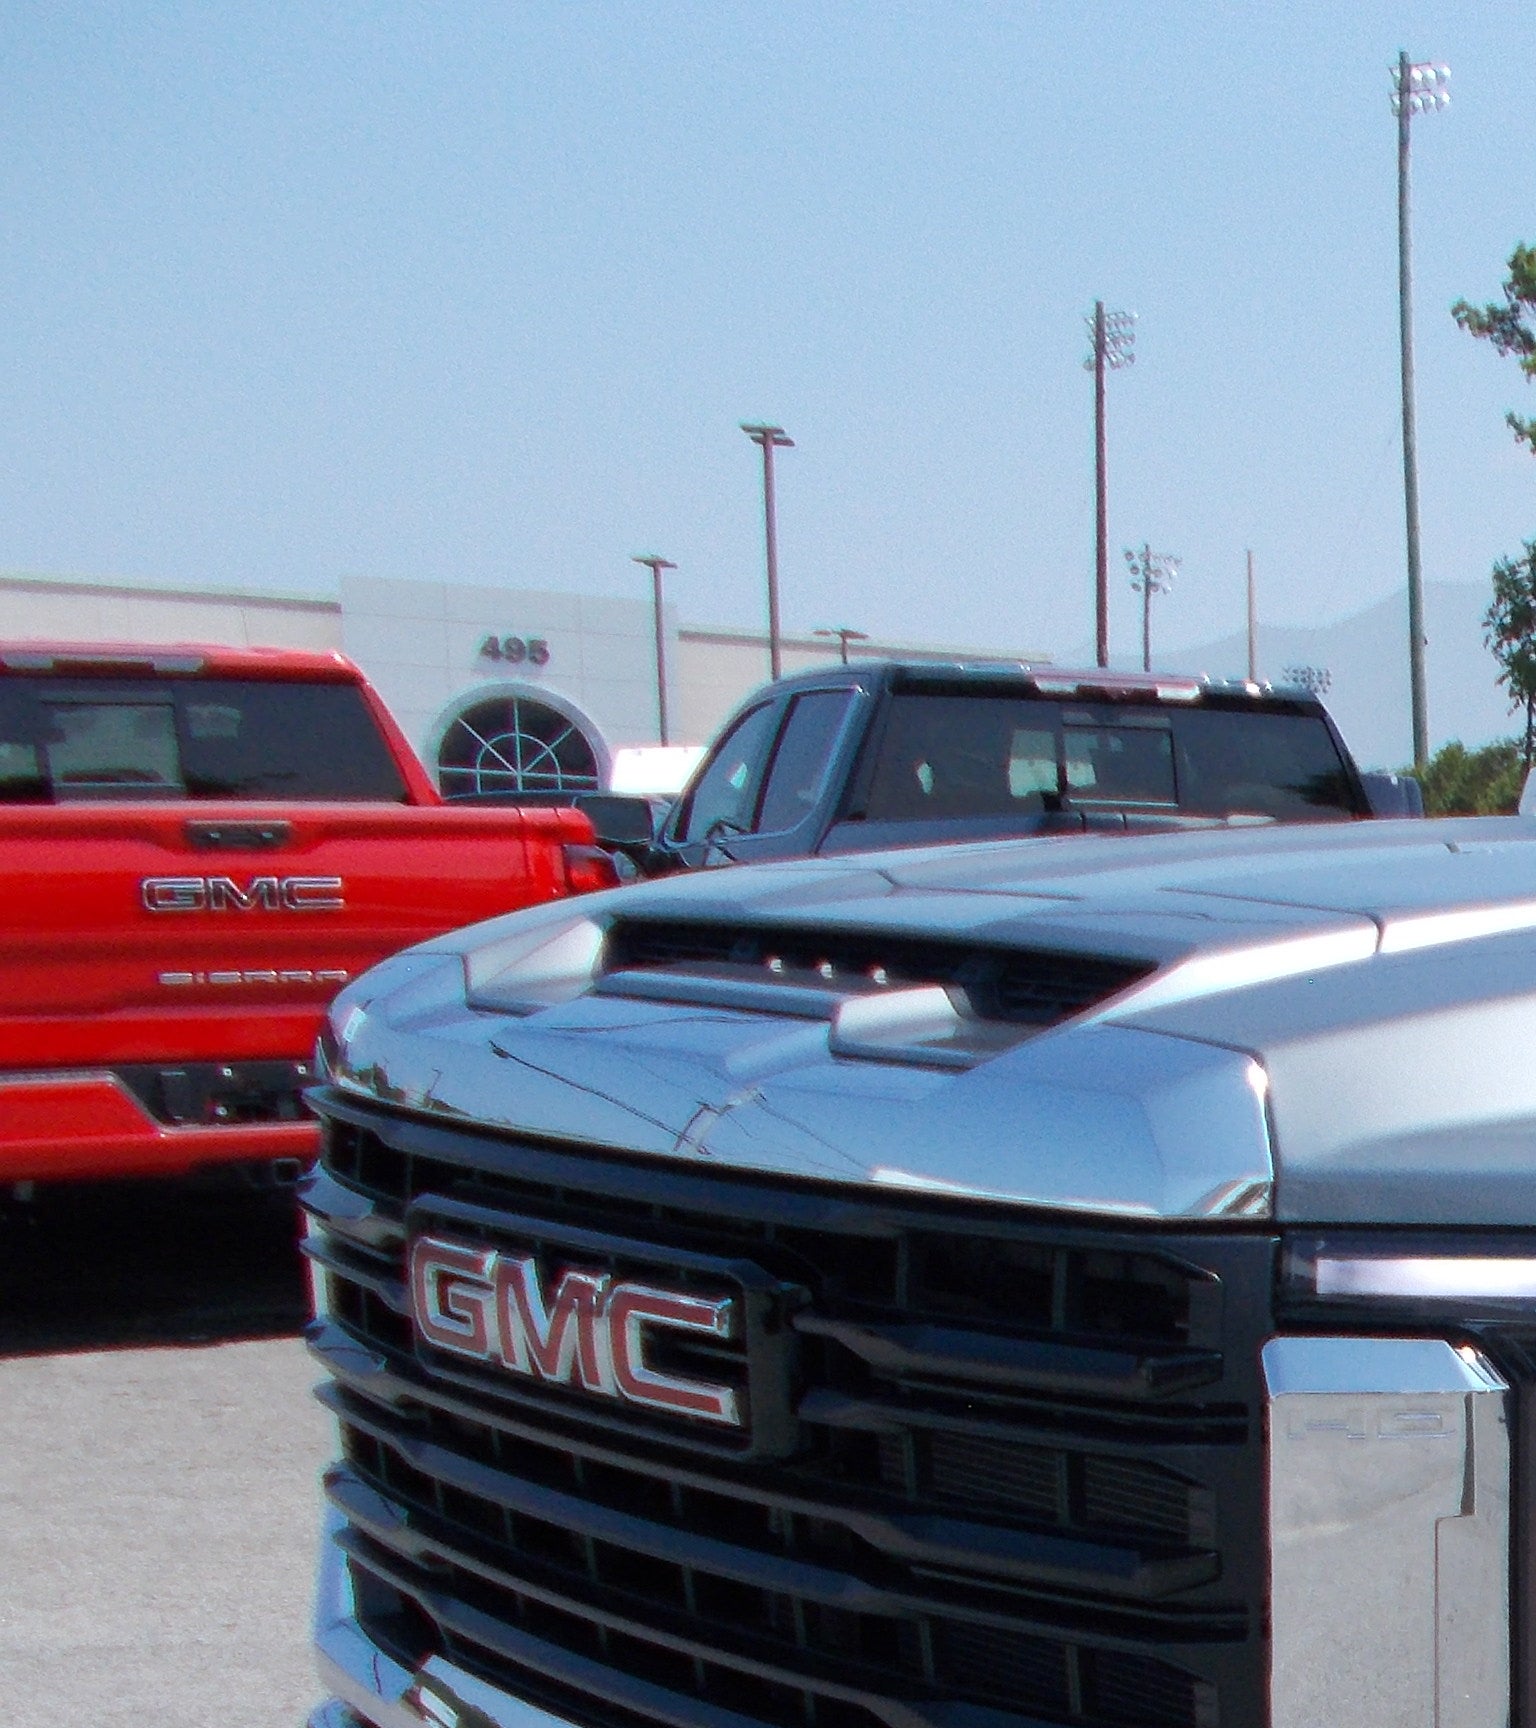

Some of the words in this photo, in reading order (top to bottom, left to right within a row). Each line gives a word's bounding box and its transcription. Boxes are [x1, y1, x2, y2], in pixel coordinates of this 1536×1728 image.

[480, 636, 550, 665] 495
[142, 876, 345, 911] GMC
[158, 969, 348, 984] SIERRA
[410, 1235, 741, 1428] GMC
[1287, 1408, 1457, 1440] HD
